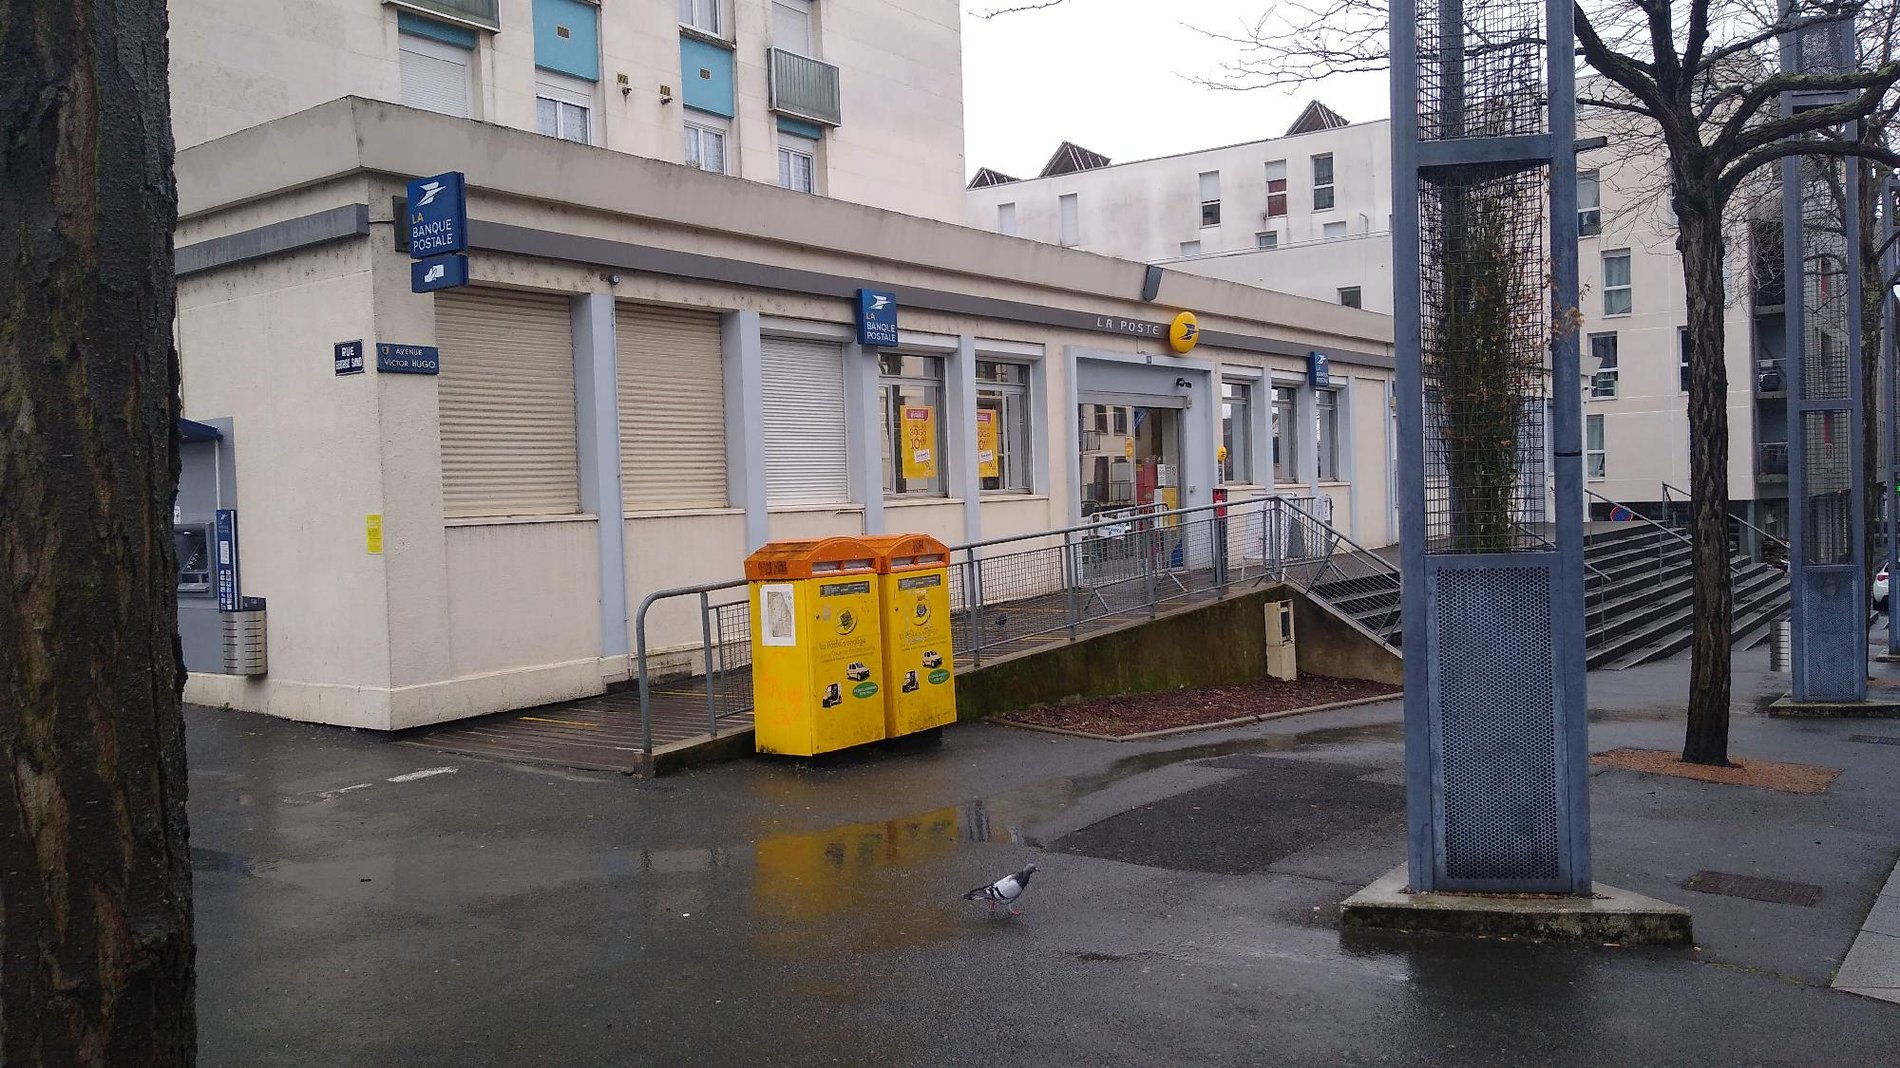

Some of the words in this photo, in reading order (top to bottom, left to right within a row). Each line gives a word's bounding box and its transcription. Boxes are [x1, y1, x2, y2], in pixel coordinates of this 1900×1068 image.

[412, 212, 424, 224] LA
[412, 219, 452, 238] BANQUE
[413, 233, 453, 251] POSTALE
[866, 312, 876, 320] LA
[866, 321, 896, 333] BANQUE
[1096, 317, 1113, 328] LA
[1120, 321, 1160, 335] POSTE
[866, 331, 896, 342] POSTALE
[341, 346, 355, 357] RUE
[395, 348, 423, 356] AVENUE
[411, 360, 436, 369] HUGO
